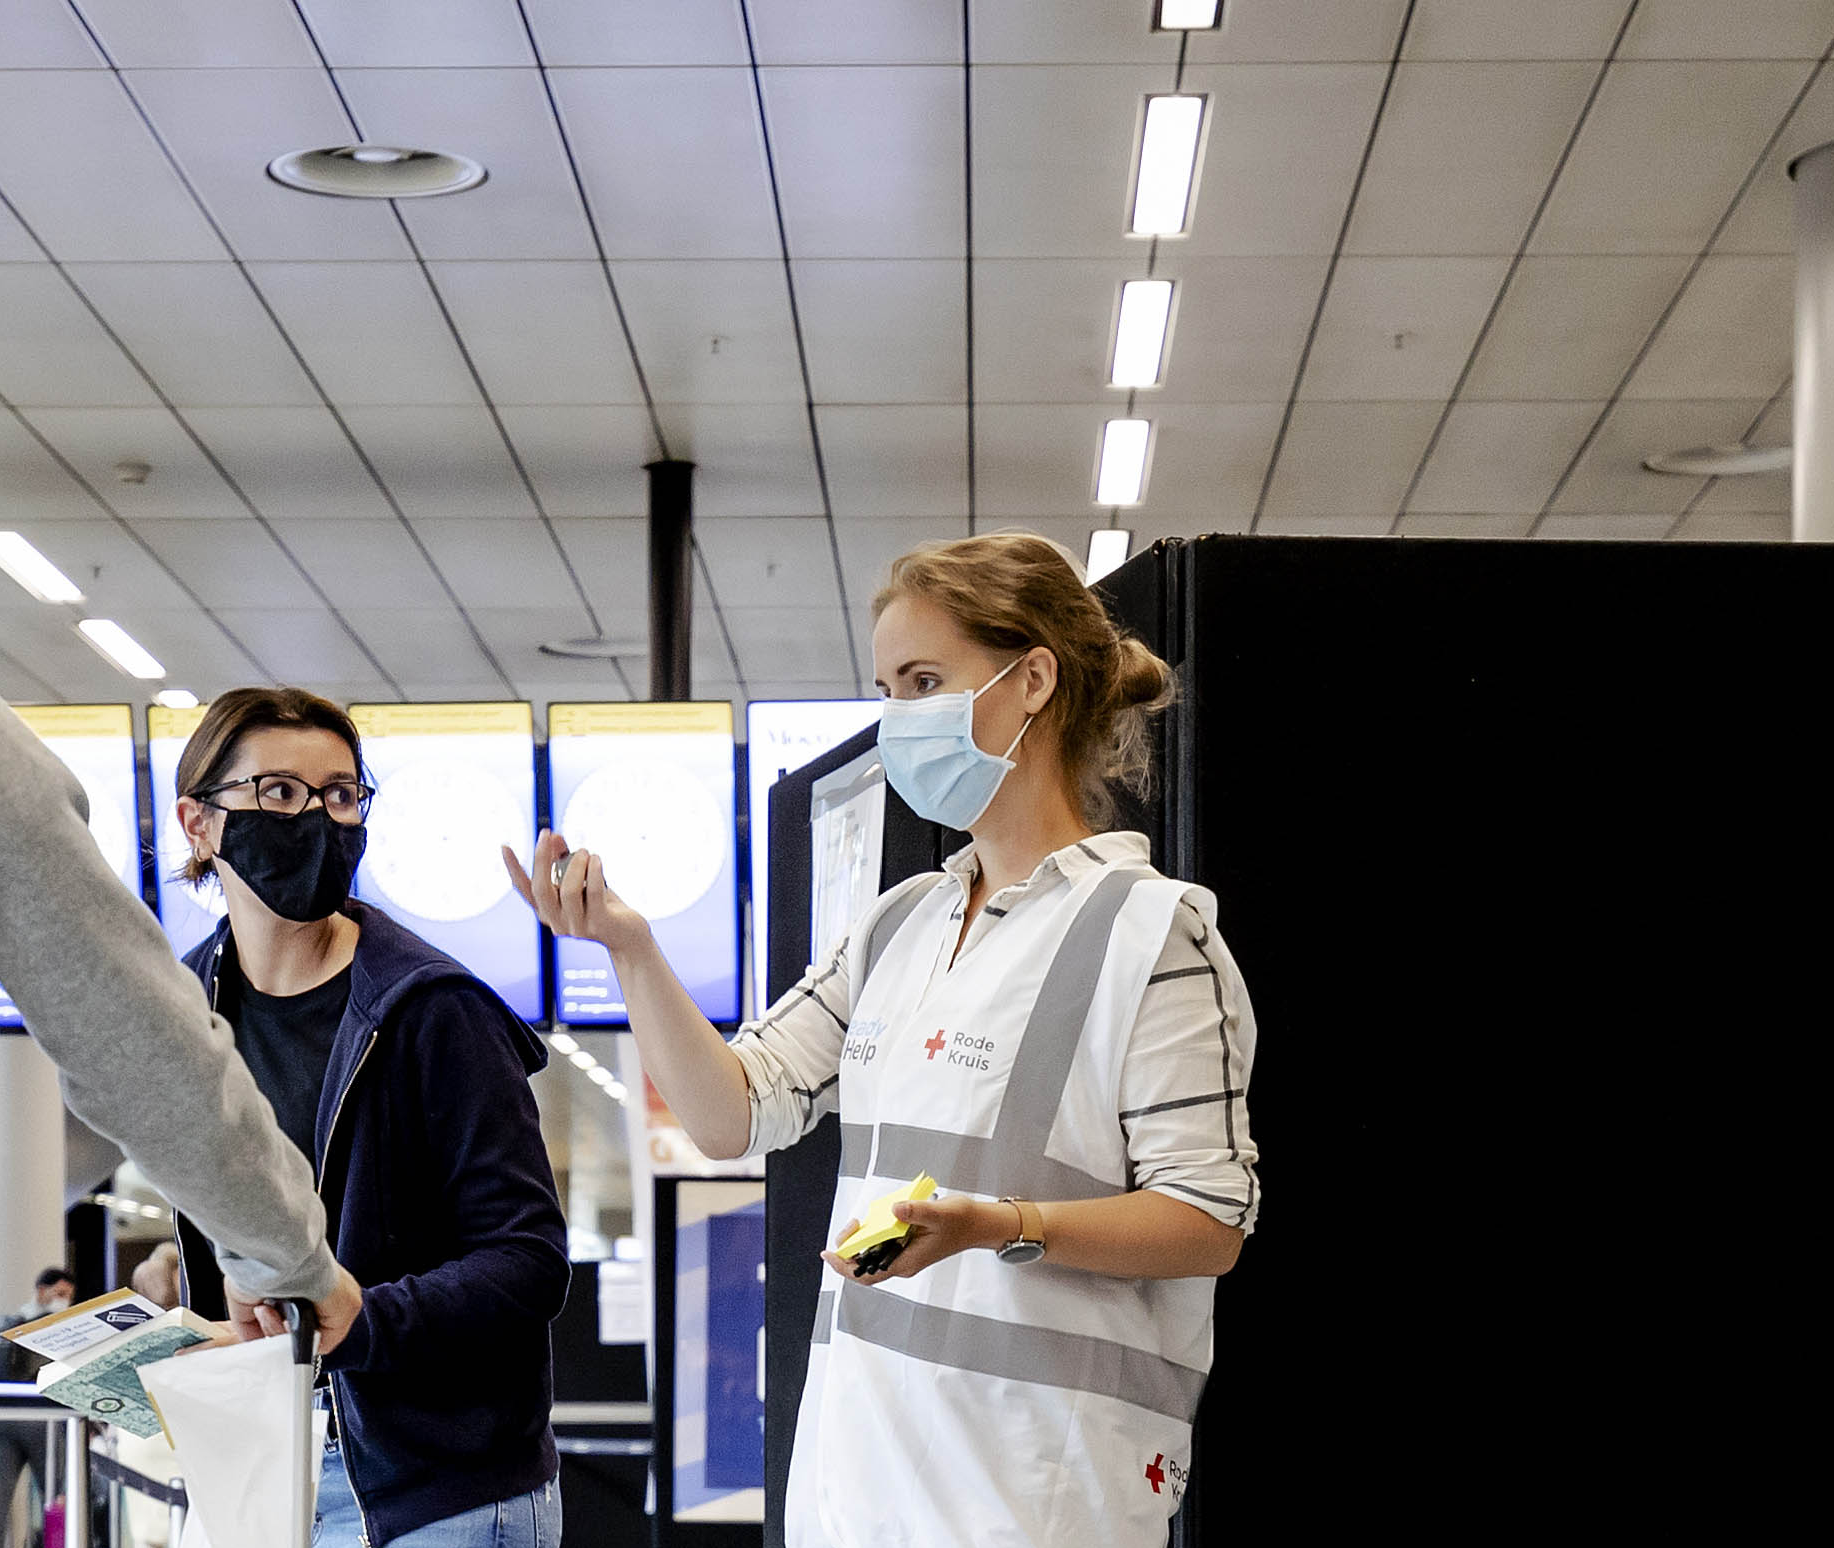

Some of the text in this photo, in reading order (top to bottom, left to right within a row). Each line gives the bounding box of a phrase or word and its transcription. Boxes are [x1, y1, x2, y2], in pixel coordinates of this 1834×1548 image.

[848, 1018, 887, 1037] eady
[843, 1039, 876, 1065] Help
[953, 1032, 995, 1052] Rode
[947, 1050, 990, 1071] Kruis
[1170, 1460, 1189, 1483] Rod
